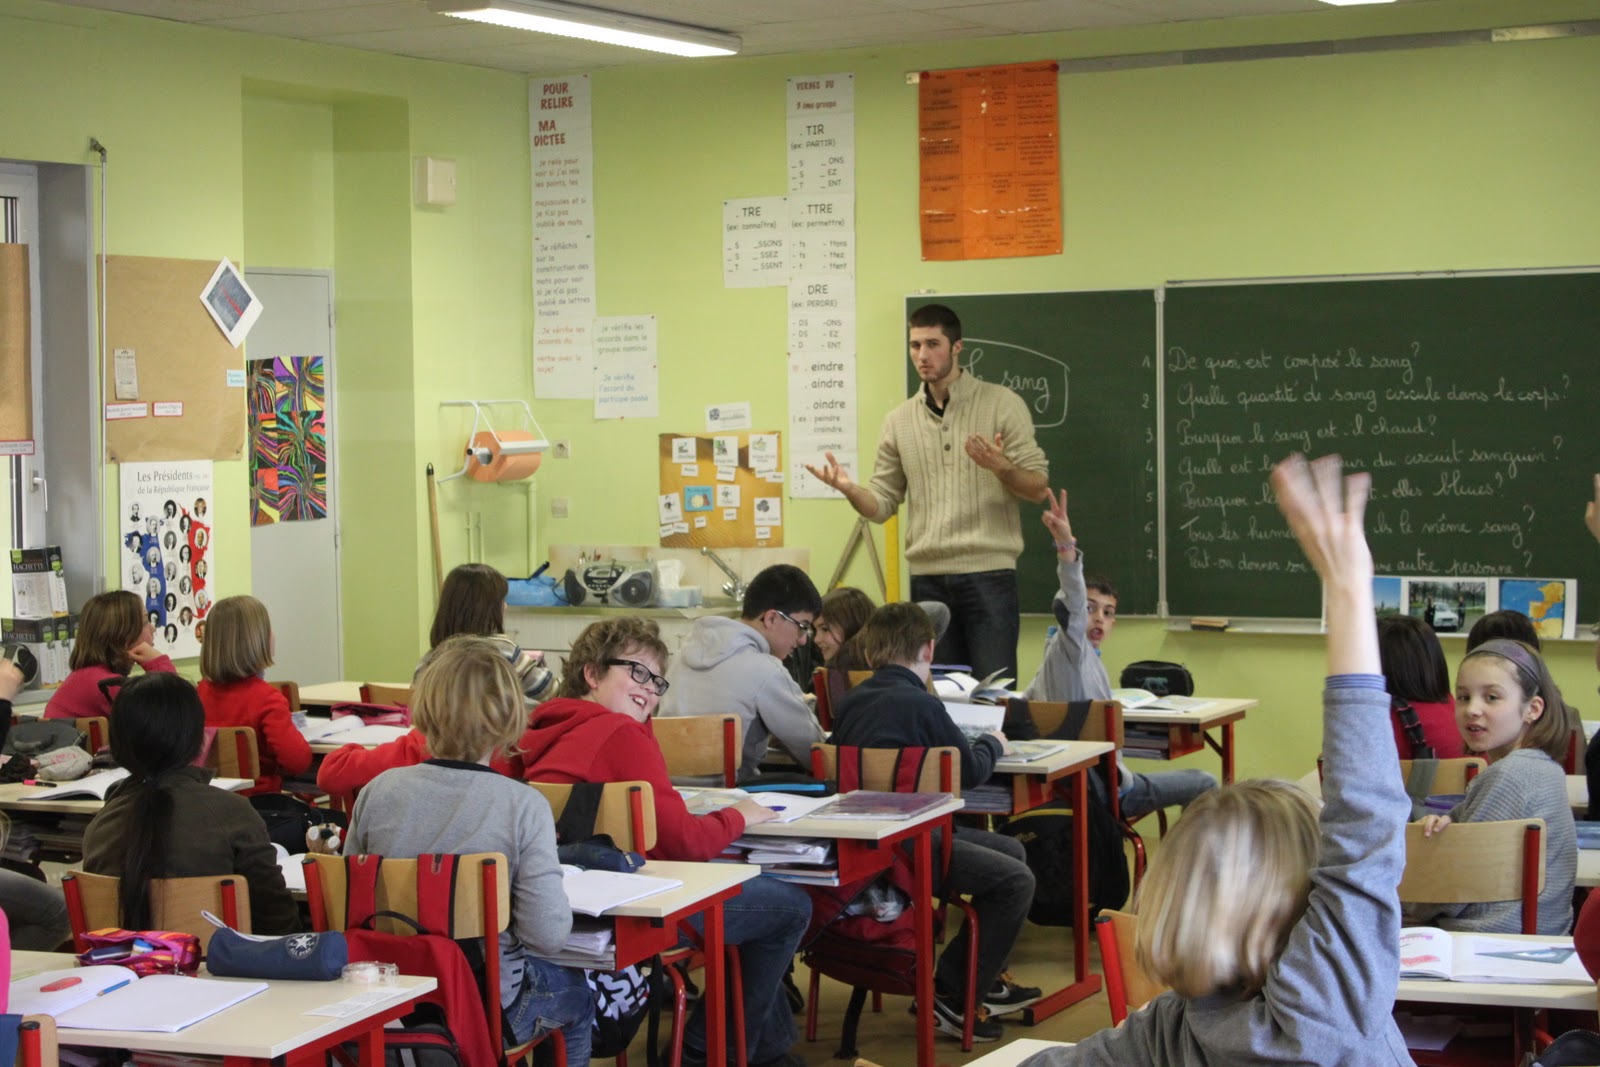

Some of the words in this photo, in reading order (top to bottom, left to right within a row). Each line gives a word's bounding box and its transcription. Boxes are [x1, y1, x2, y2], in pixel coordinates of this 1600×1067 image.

[543, 82, 568, 96] POUR
[796, 81, 820, 90] VERBES
[540, 96, 573, 110] RELIRE
[538, 120, 556, 132] MA
[806, 124, 825, 136] TIR
[534, 133, 566, 147] DICTEE
[564, 158, 579, 166] pour
[742, 206, 761, 218] TRE
[806, 204, 833, 214] TTRE
[808, 284, 828, 295] DRE
[811, 360, 844, 372] eindre
[1168, 346, 1197, 372] De
[1244, 348, 1272, 369] est
[1284, 350, 1340, 380] composé
[1345, 347, 1363, 368] le
[811, 378, 844, 388] aindre
[1001, 370, 1051, 414] sang
[1142, 393, 1150, 409] 2
[1178, 382, 1230, 419] Quelle
[1238, 380, 1298, 413] quantité
[1304, 384, 1322, 402] de
[1329, 389, 1377, 412] sang
[1386, 376, 1441, 400] circule
[1447, 384, 1488, 402] dans
[1494, 376, 1514, 402] le
[813, 398, 846, 410] oindre
[814, 415, 840, 424] peindre
[1248, 422, 1264, 443] le
[1272, 430, 1312, 453] sang
[816, 443, 842, 452] joindre
[1146, 460, 1154, 472] 4
[1178, 456, 1223, 483] Quelle
[1230, 456, 1252, 474] est
[1373, 452, 1396, 468] du
[1405, 438, 1464, 466] circuit
[1469, 447, 1547, 479] sanguin
[137, 472, 152, 482] Les
[154, 469, 193, 482] Présidents
[137, 486, 146, 494] de
[146, 486, 152, 494] la
[1146, 492, 1154, 502] 5
[1144, 521, 1154, 534] 6
[1180, 516, 1214, 542] Tous
[1218, 522, 1239, 540] les
[1400, 509, 1413, 534] le
[1422, 513, 1472, 534] même
[13, 562, 44, 571] HACHETTE
[1238, 552, 1280, 571] donner
[1396, 548, 1440, 574] autre
[1445, 560, 1514, 578] personne
